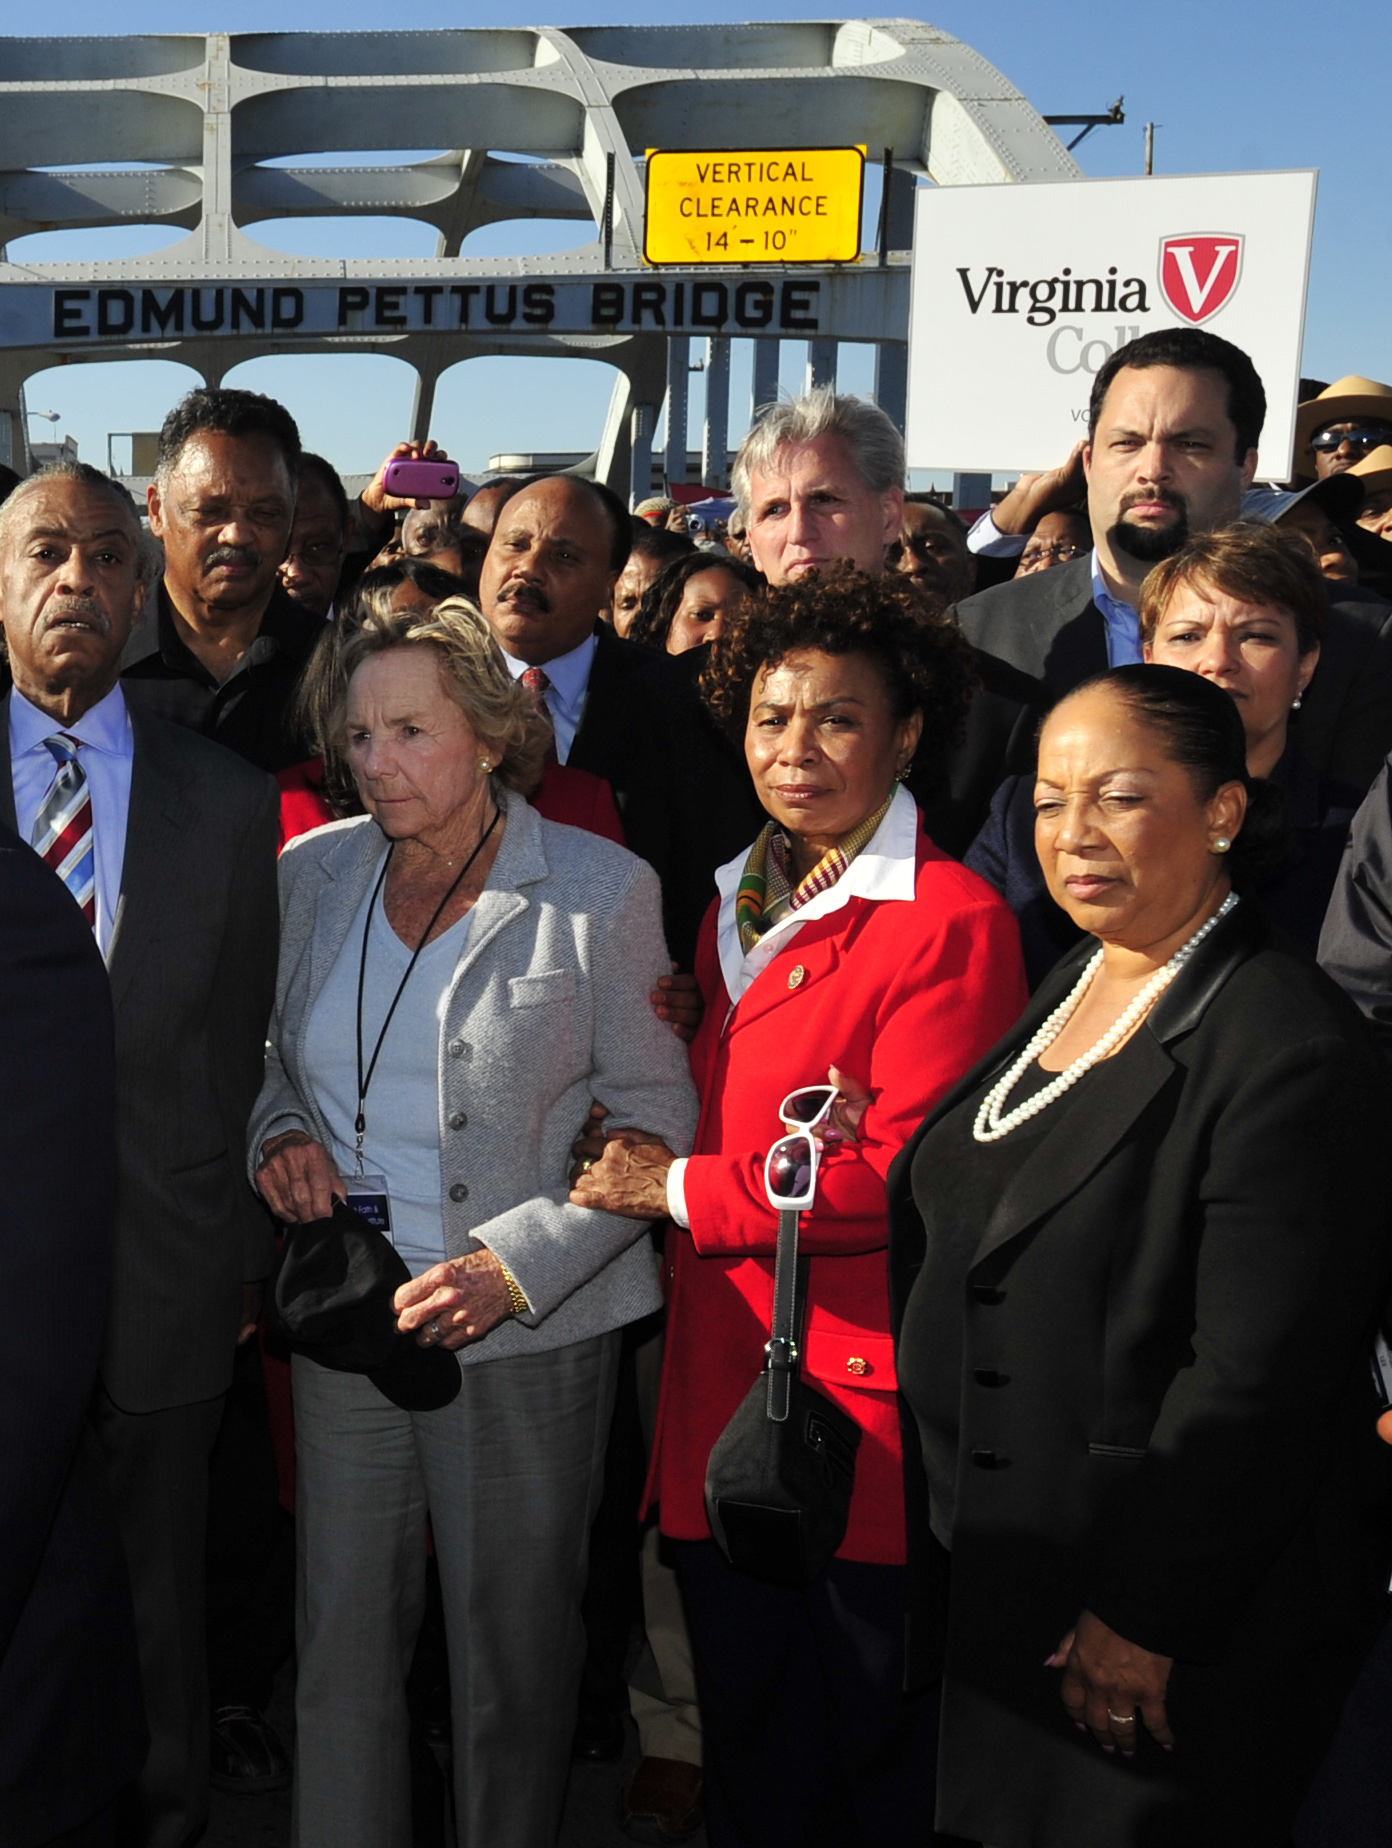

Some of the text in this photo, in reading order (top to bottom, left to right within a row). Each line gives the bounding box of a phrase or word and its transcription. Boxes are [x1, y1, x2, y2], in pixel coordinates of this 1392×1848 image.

[696, 161, 814, 183] VERTICAL
[679, 196, 828, 217] CLEARANCE
[54, 281, 821, 338] EDMUND PETTUS BRIDGE
[956, 266, 1151, 326] Virginia
